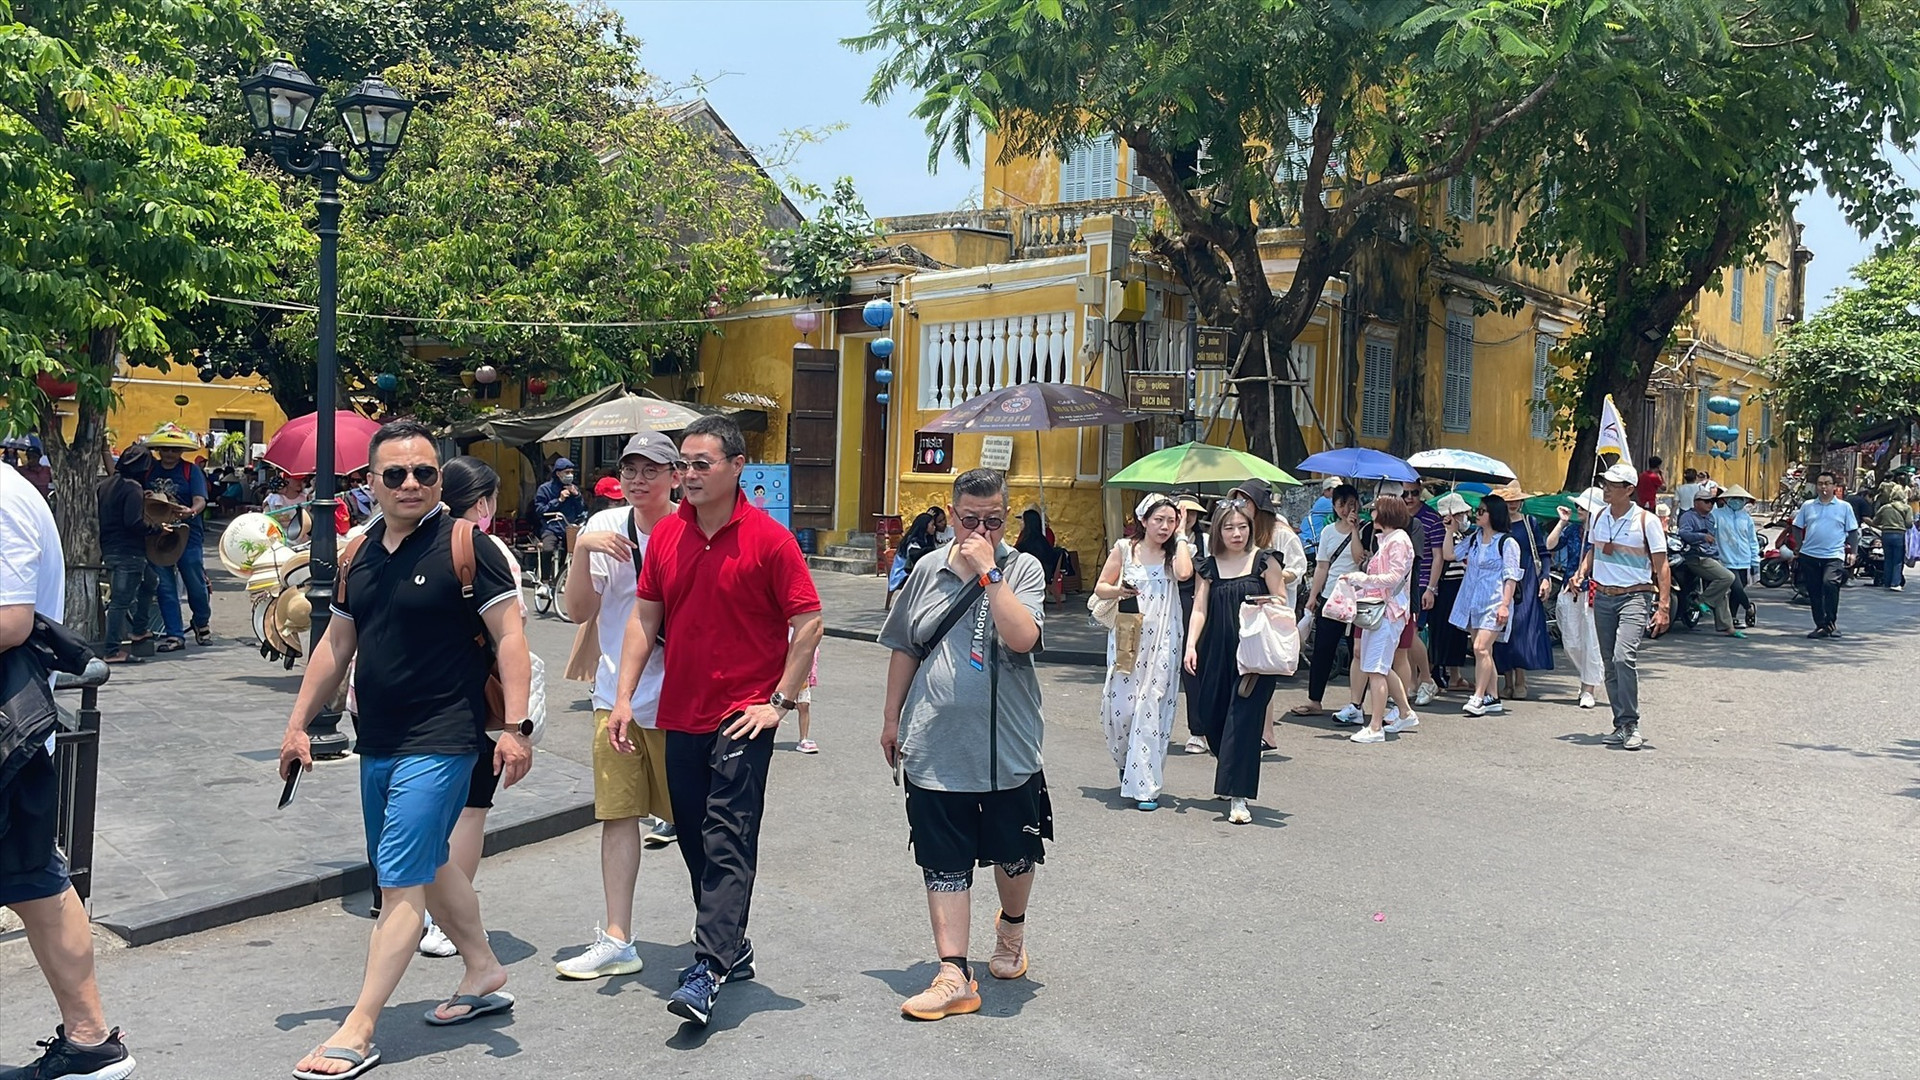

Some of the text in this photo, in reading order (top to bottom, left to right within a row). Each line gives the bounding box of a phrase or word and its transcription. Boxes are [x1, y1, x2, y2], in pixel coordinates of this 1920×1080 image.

[1152, 381, 1170, 390] ĐƯỜNG
[1142, 396, 1156, 406] BẠCH
[920, 436, 945, 448] mister
